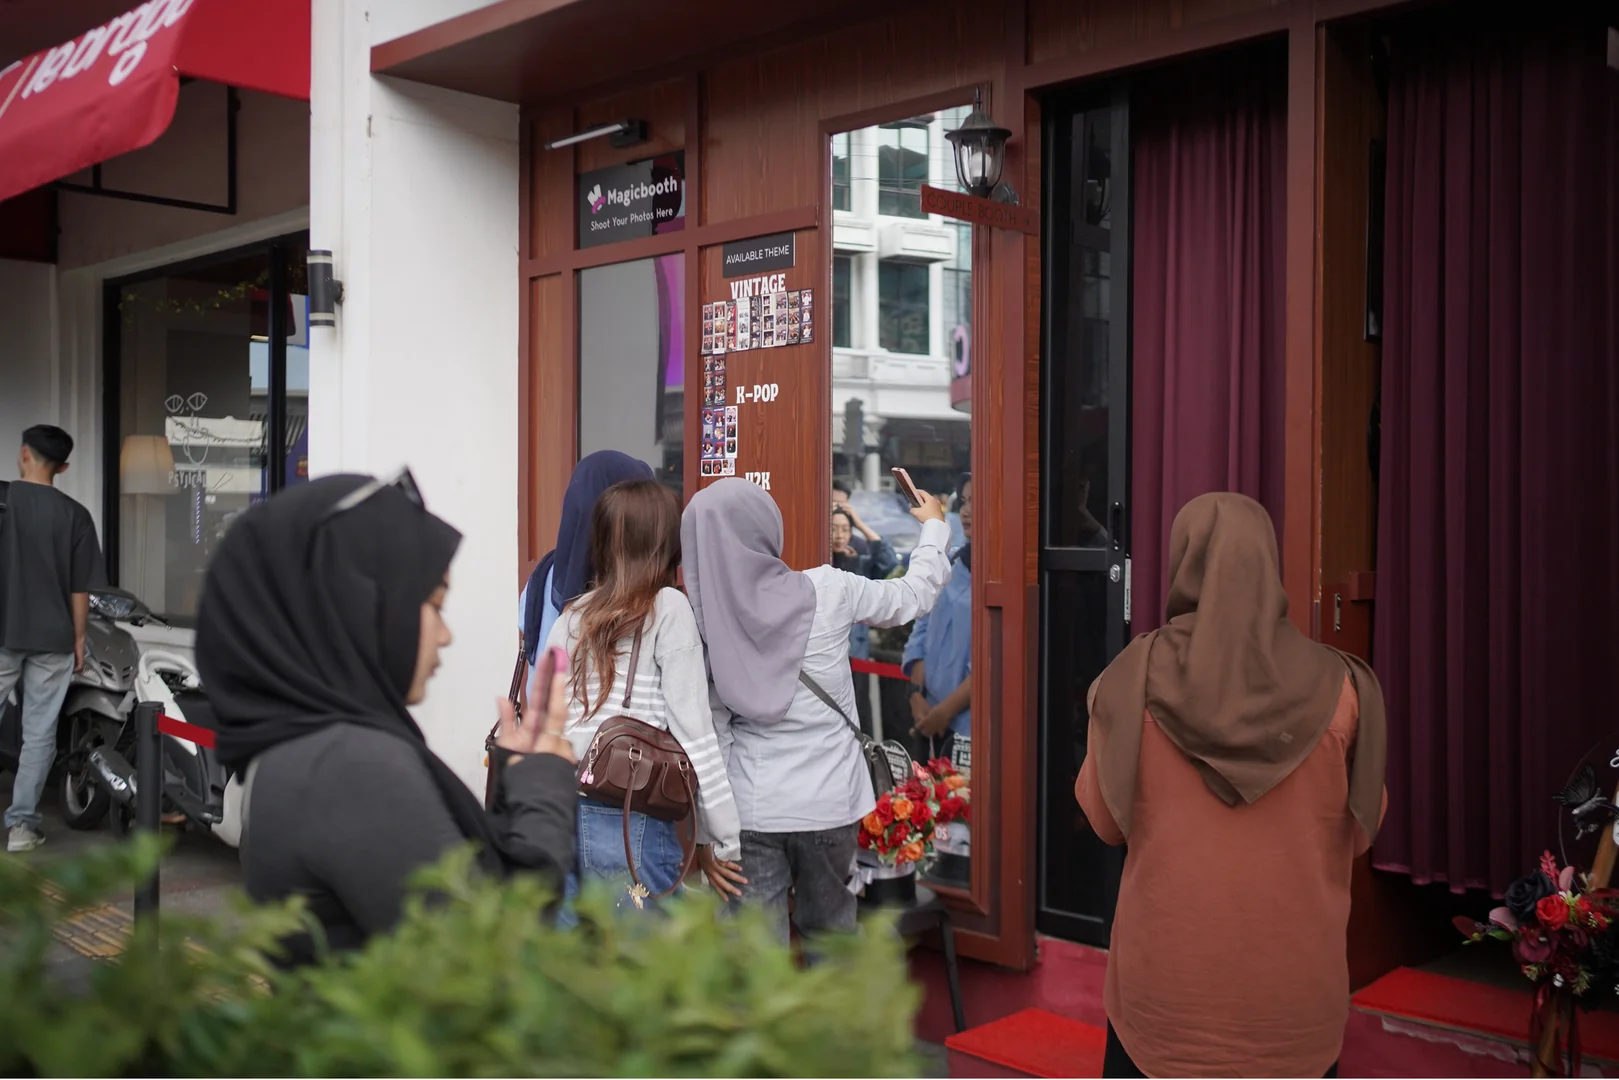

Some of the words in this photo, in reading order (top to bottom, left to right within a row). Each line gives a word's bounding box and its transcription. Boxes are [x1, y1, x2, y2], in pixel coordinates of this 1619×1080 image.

[607, 176, 678, 207] Magicbooth
[590, 219, 611, 232] Shoot
[612, 216, 629, 228] Your
[630, 211, 655, 224] Photos
[656, 207, 674, 219] Here
[927, 193, 973, 217] COUPLE
[978, 203, 1018, 226] BOOTH
[725, 248, 764, 265] AVAILABLE
[764, 244, 790, 257] THEME
[730, 273, 786, 300] VINTAGE
[736, 383, 779, 404] K-POP
